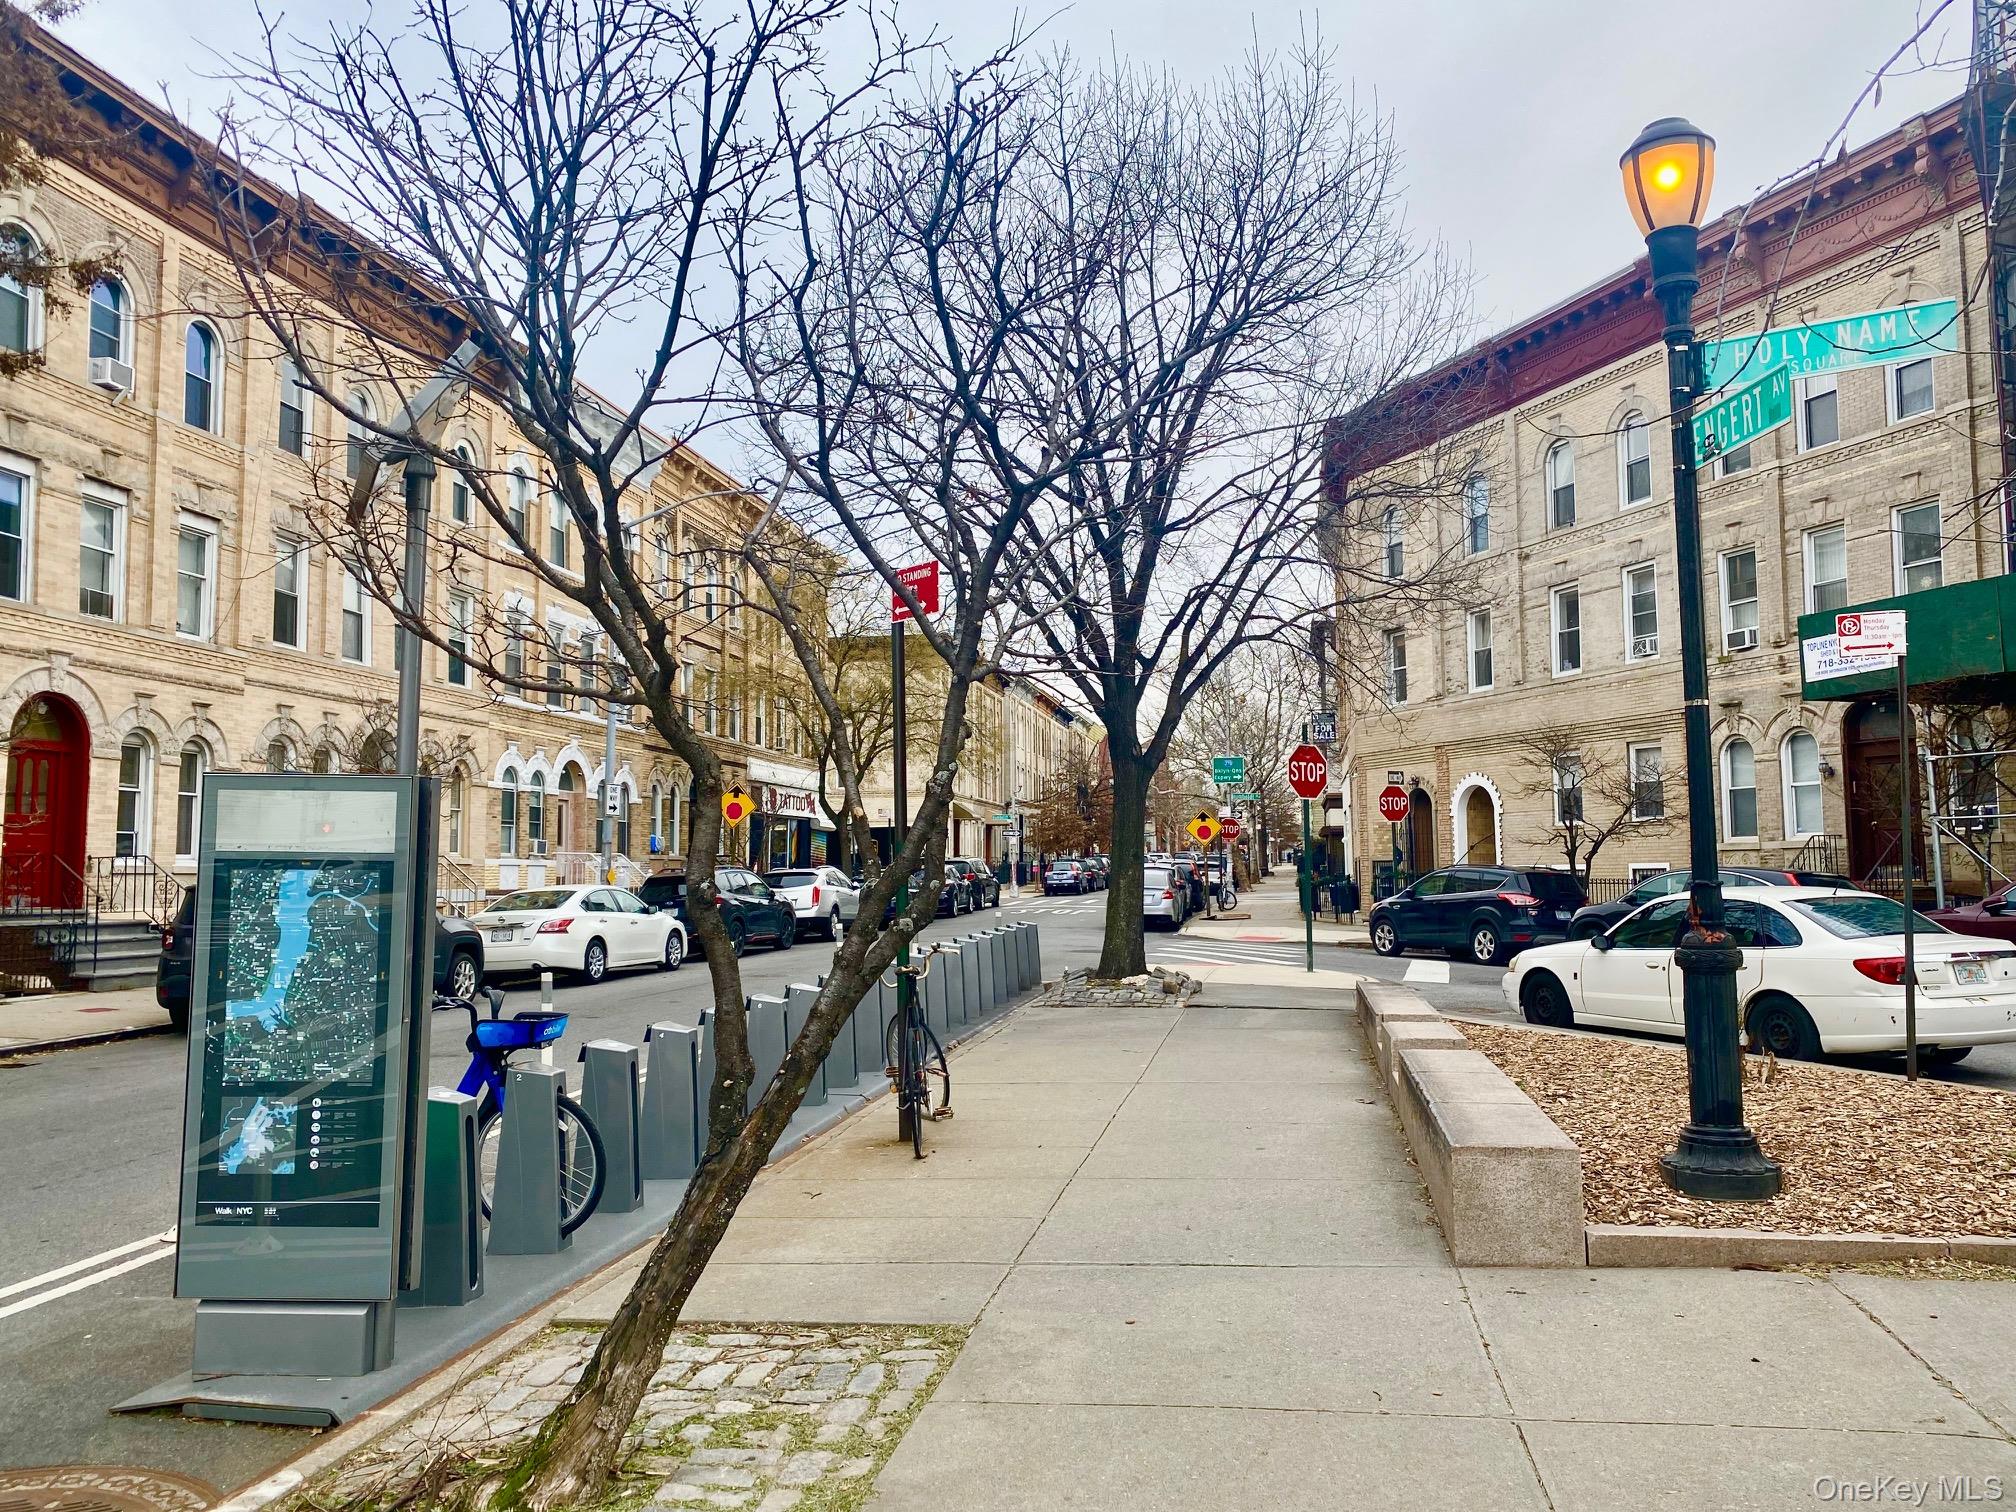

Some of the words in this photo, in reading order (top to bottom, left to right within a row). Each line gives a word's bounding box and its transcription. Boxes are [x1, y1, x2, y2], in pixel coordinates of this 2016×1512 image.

[1734, 330, 1811, 369] HOLY
[1836, 310, 1920, 348] NAME
[1790, 351, 1861, 374] SQUARE
[1771, 374, 1786, 400] AV
[902, 567, 931, 583] STANDING
[1290, 761, 1325, 783] STOP
[779, 792, 805, 811] TATTOO
[1380, 797, 1407, 811] STOP
[1221, 825, 1239, 834] STOP
[214, 1207, 233, 1215] Walk
[236, 1207, 253, 1215] NYC
